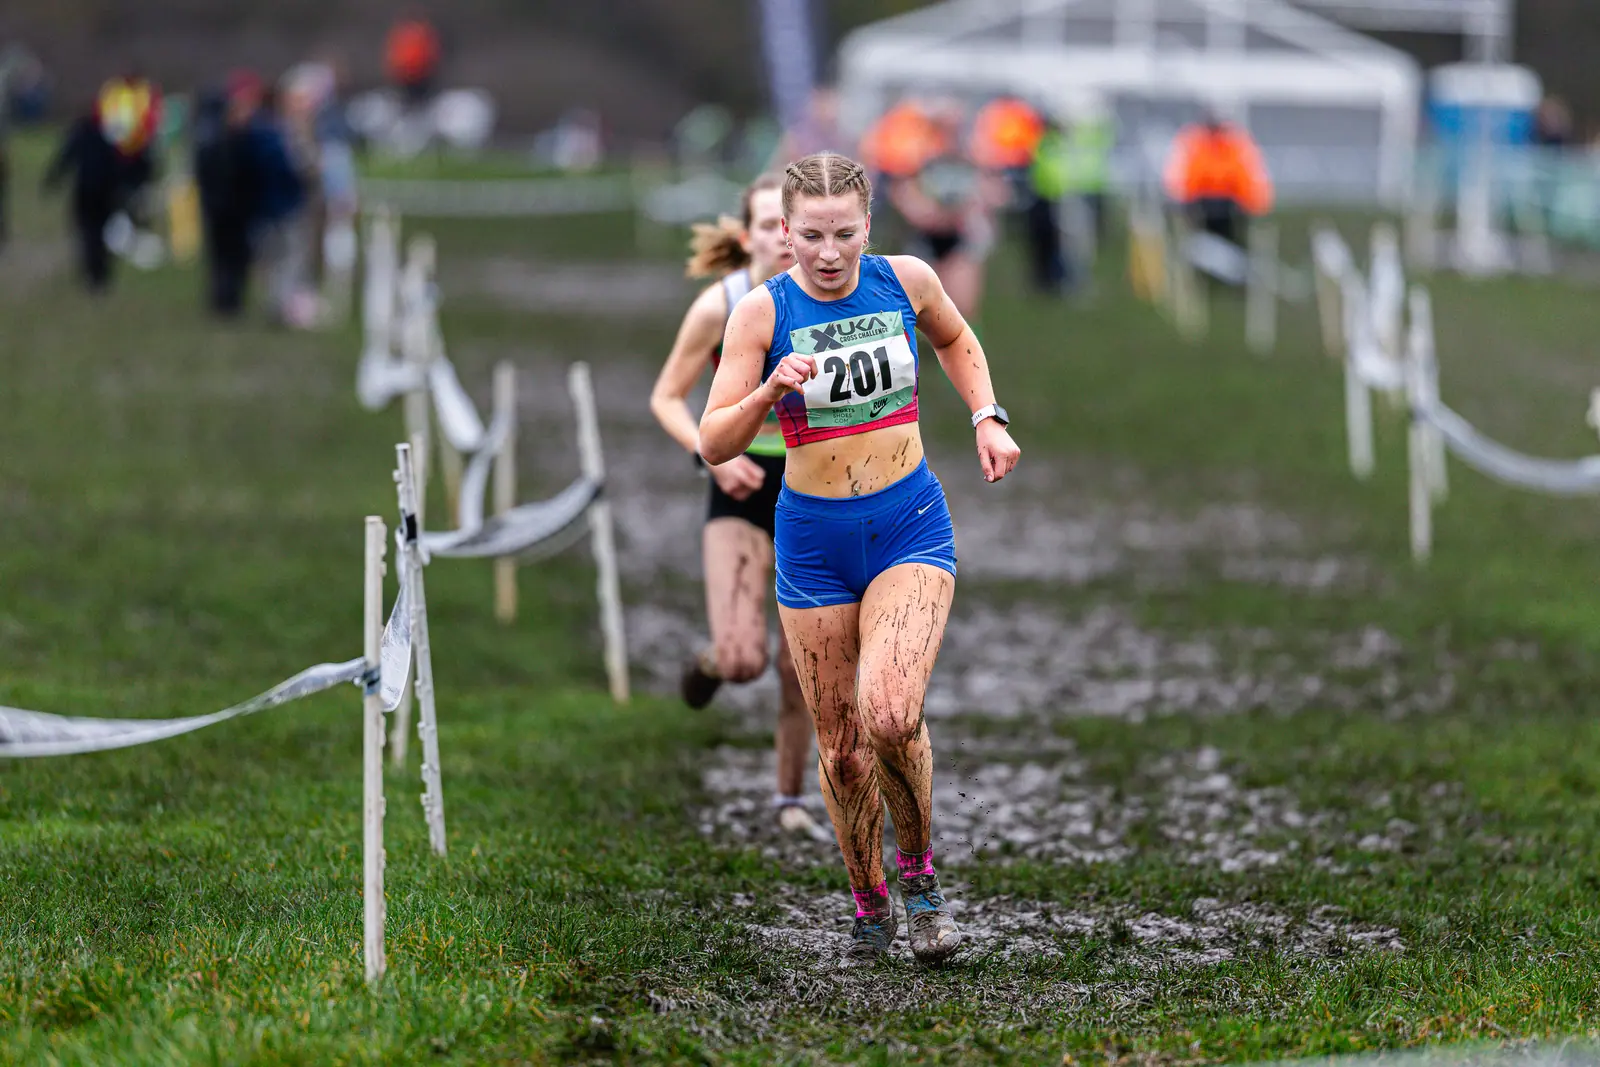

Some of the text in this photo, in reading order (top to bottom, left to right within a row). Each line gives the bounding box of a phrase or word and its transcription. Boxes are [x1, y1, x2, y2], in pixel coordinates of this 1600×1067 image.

[839, 327, 889, 344] CROSS CHALLENGE
[823, 346, 892, 403] 201
